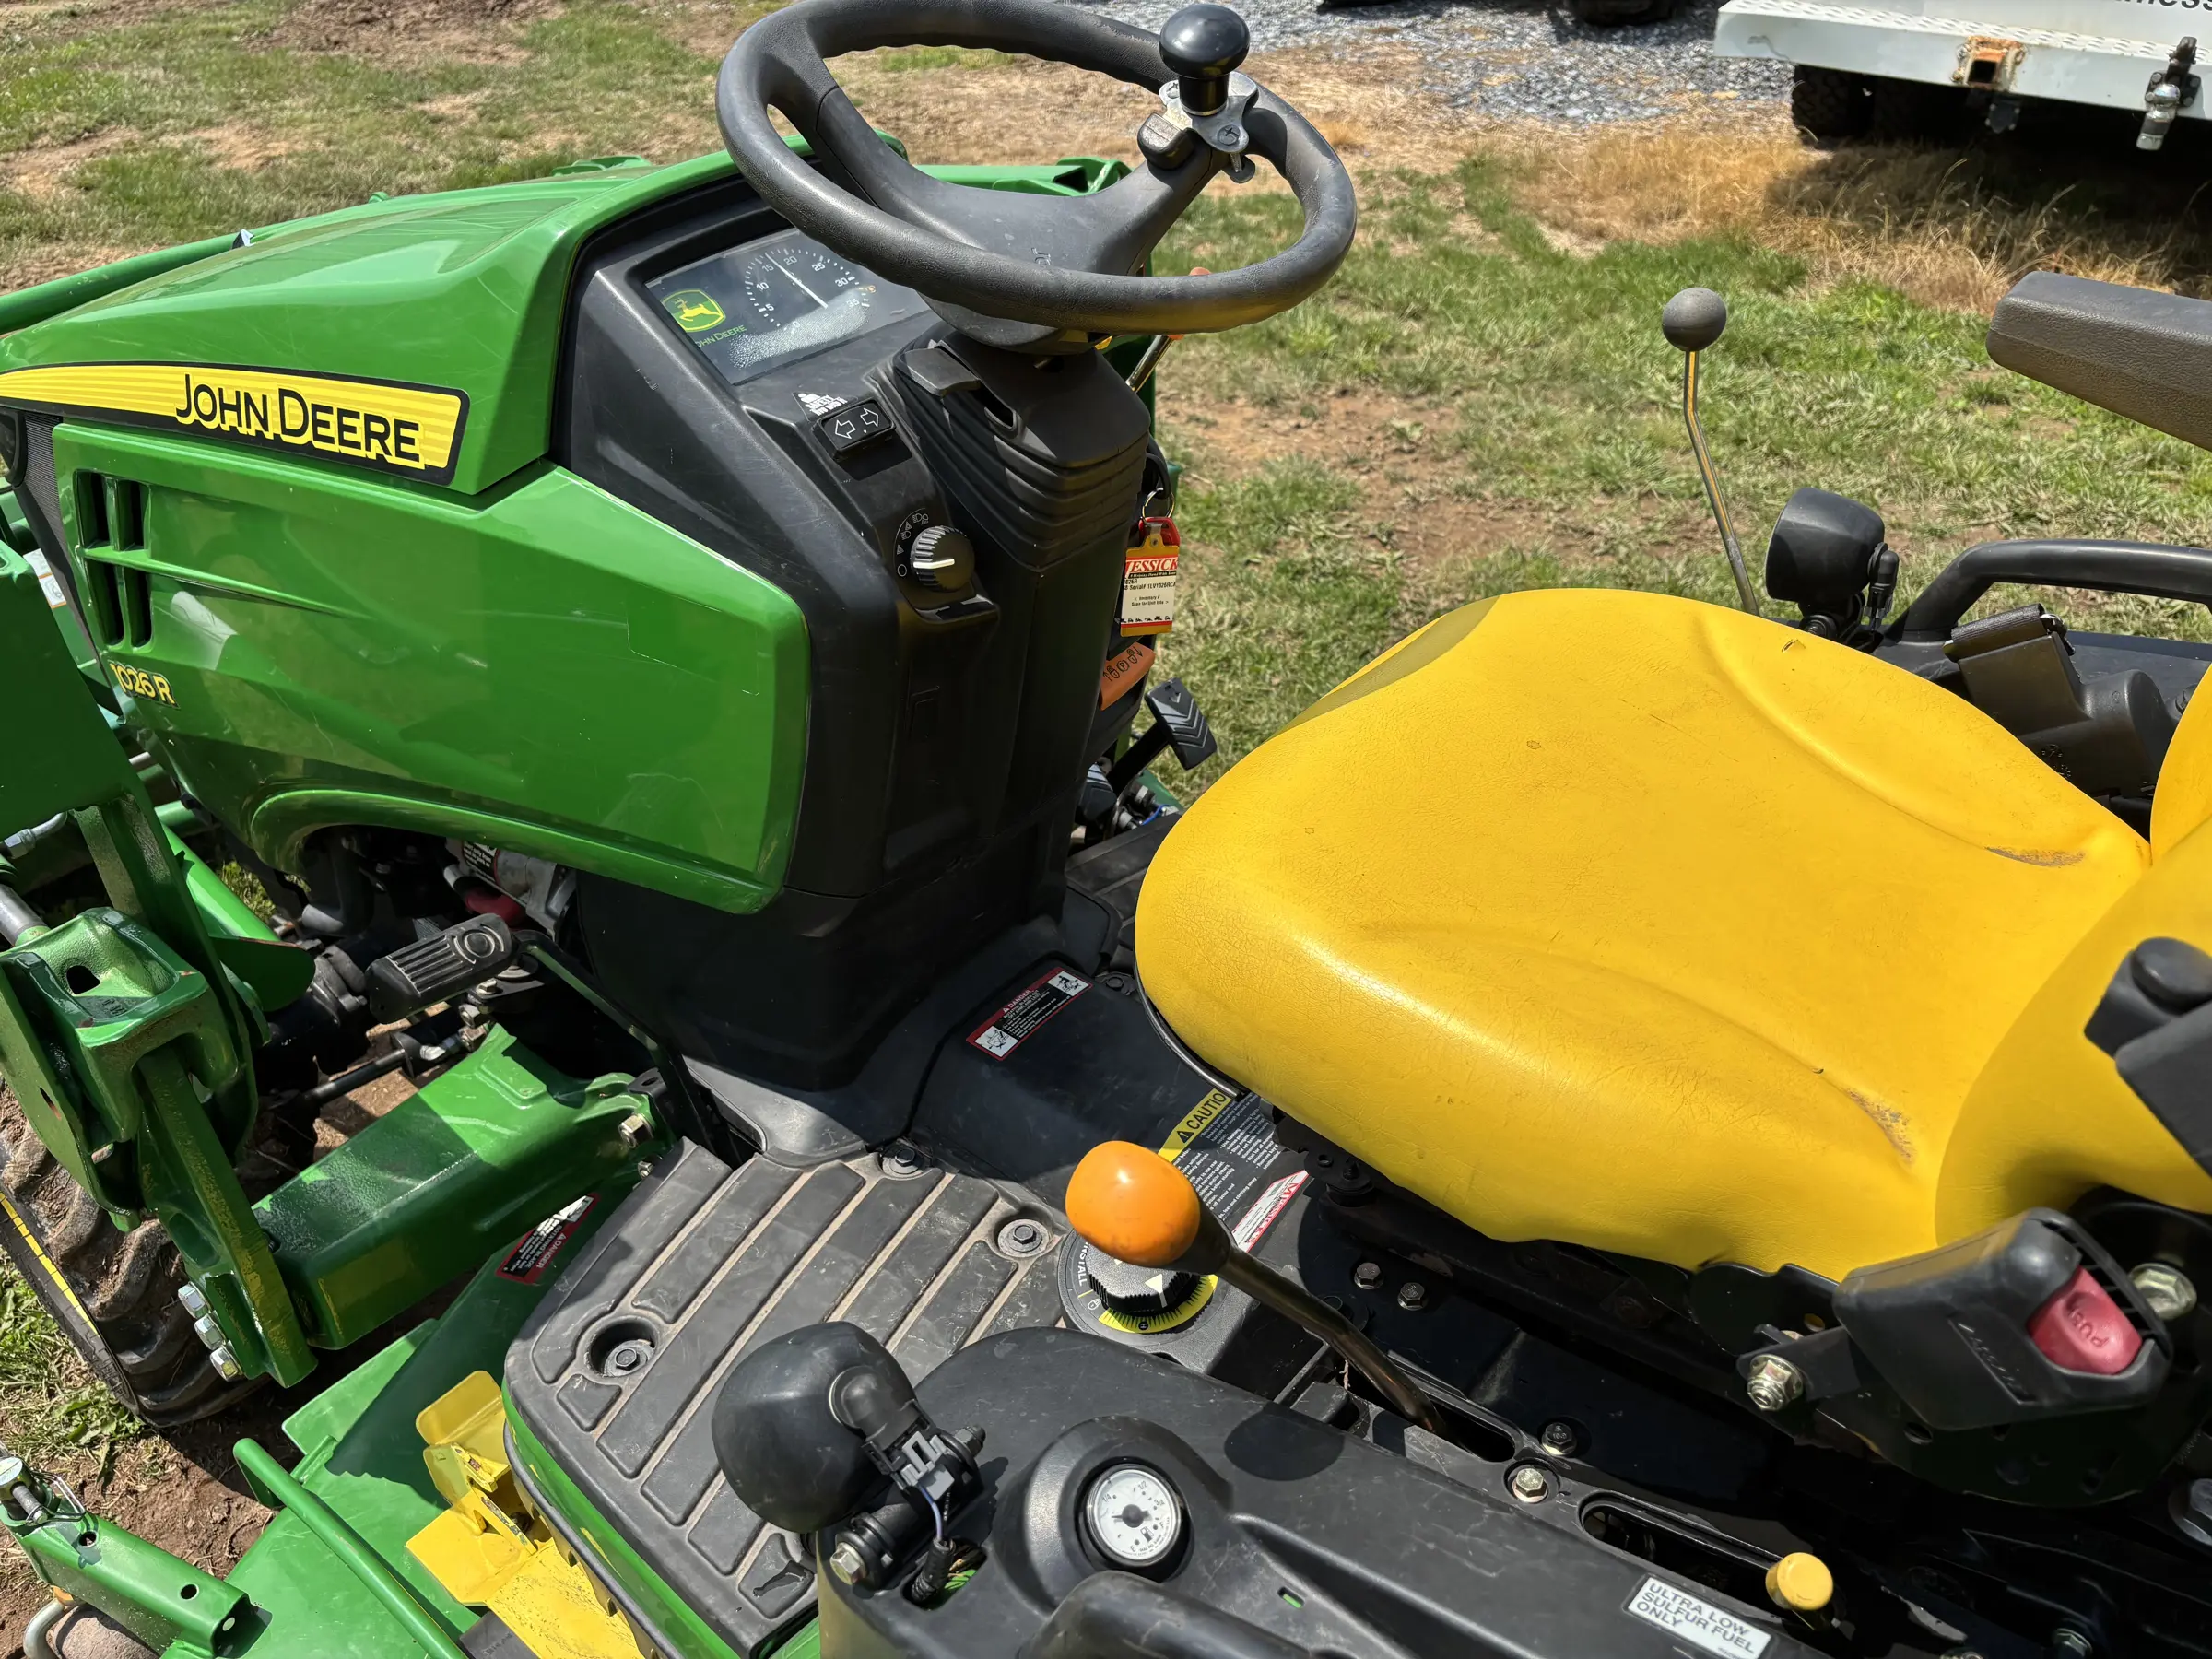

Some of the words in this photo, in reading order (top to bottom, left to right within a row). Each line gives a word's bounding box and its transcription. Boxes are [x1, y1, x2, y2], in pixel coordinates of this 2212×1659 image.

[783, 255, 798, 265] 20
[761, 264, 774, 273] 15
[811, 262, 826, 272] 25
[756, 281, 770, 291] 10
[835, 277, 849, 288] 30
[765, 303, 775, 312] 5
[846, 298, 860, 309] 35
[695, 335, 716, 347] OHN
[713, 324, 747, 343] DEERE
[175, 373, 269, 434] JOHN
[278, 388, 420, 463] DEERE
[1187, 1092, 1227, 1130] CAUTIO
[1636, 1601, 1683, 1628] ONLY
[1649, 1583, 1703, 1614] ULTRA
[1708, 1611, 1750, 1636] LOW
[1642, 1592, 1709, 1630] SULFUR
[1711, 1625, 1755, 1653] FUEL
